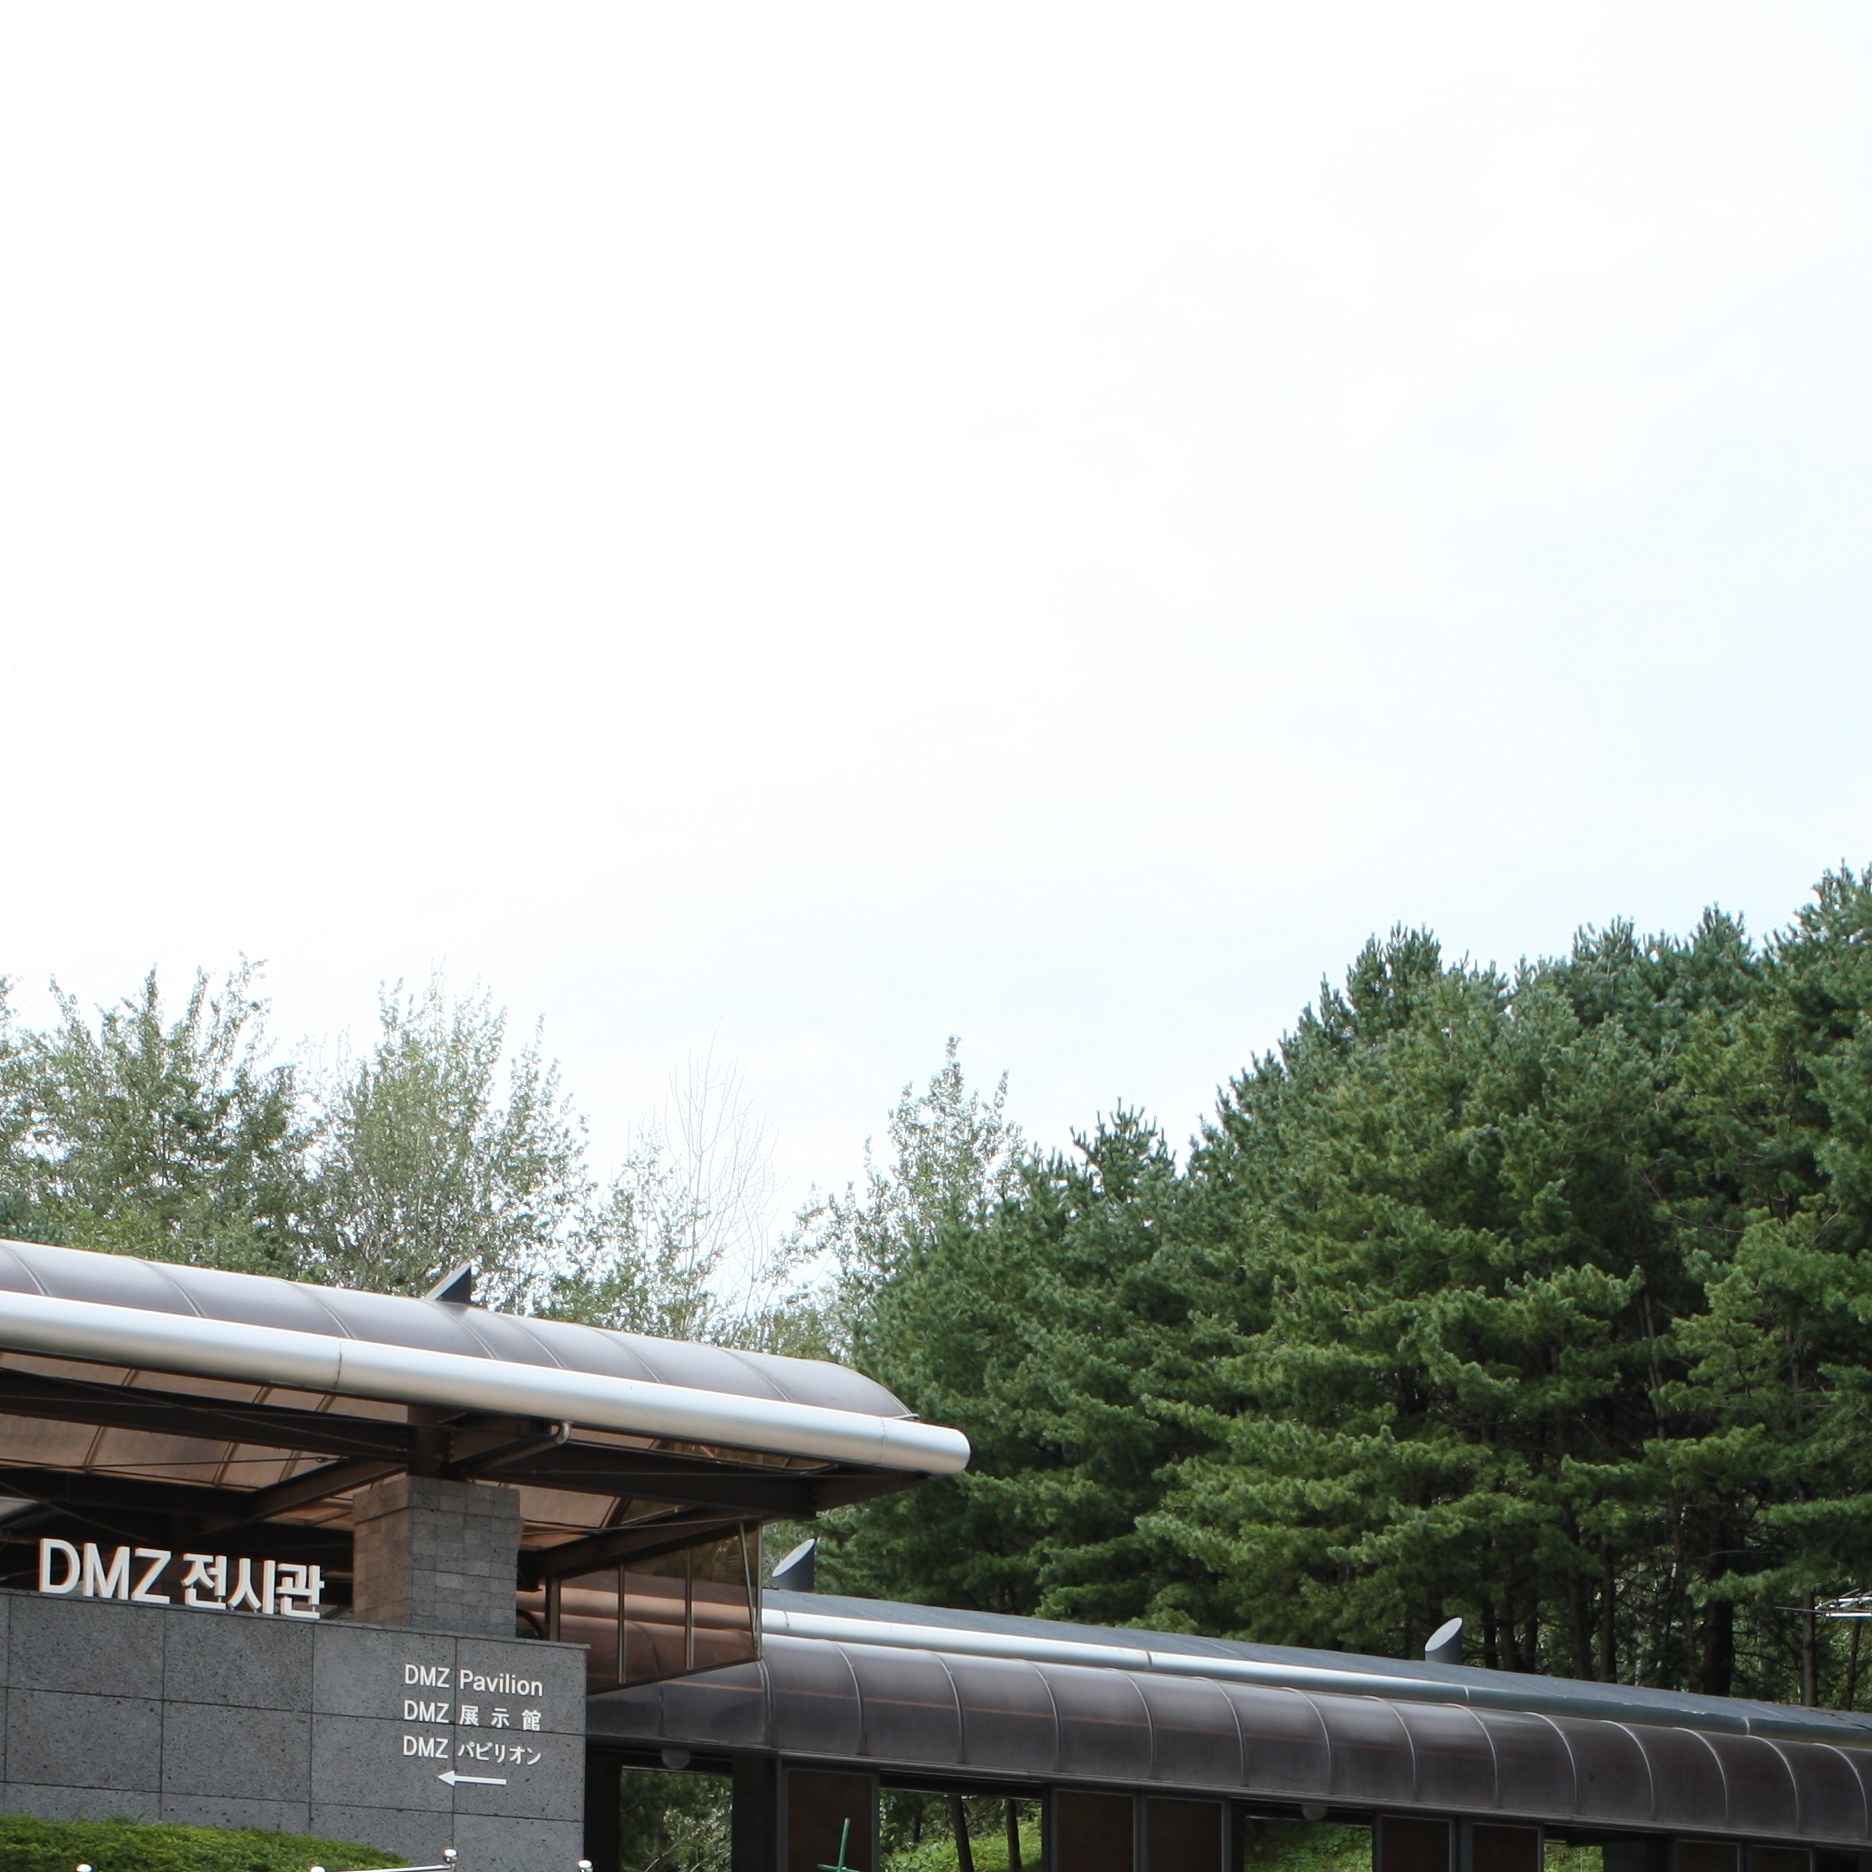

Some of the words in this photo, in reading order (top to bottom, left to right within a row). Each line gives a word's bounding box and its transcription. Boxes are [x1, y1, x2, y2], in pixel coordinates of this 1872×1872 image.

[39, 1537, 172, 1605] DMZ
[181, 1552, 325, 1620] 전시관
[404, 1664, 450, 1688] DMZ
[459, 1669, 543, 1697] Pavilion
[403, 1700, 449, 1724] DMZ
[402, 1735, 449, 1759] DMZ
